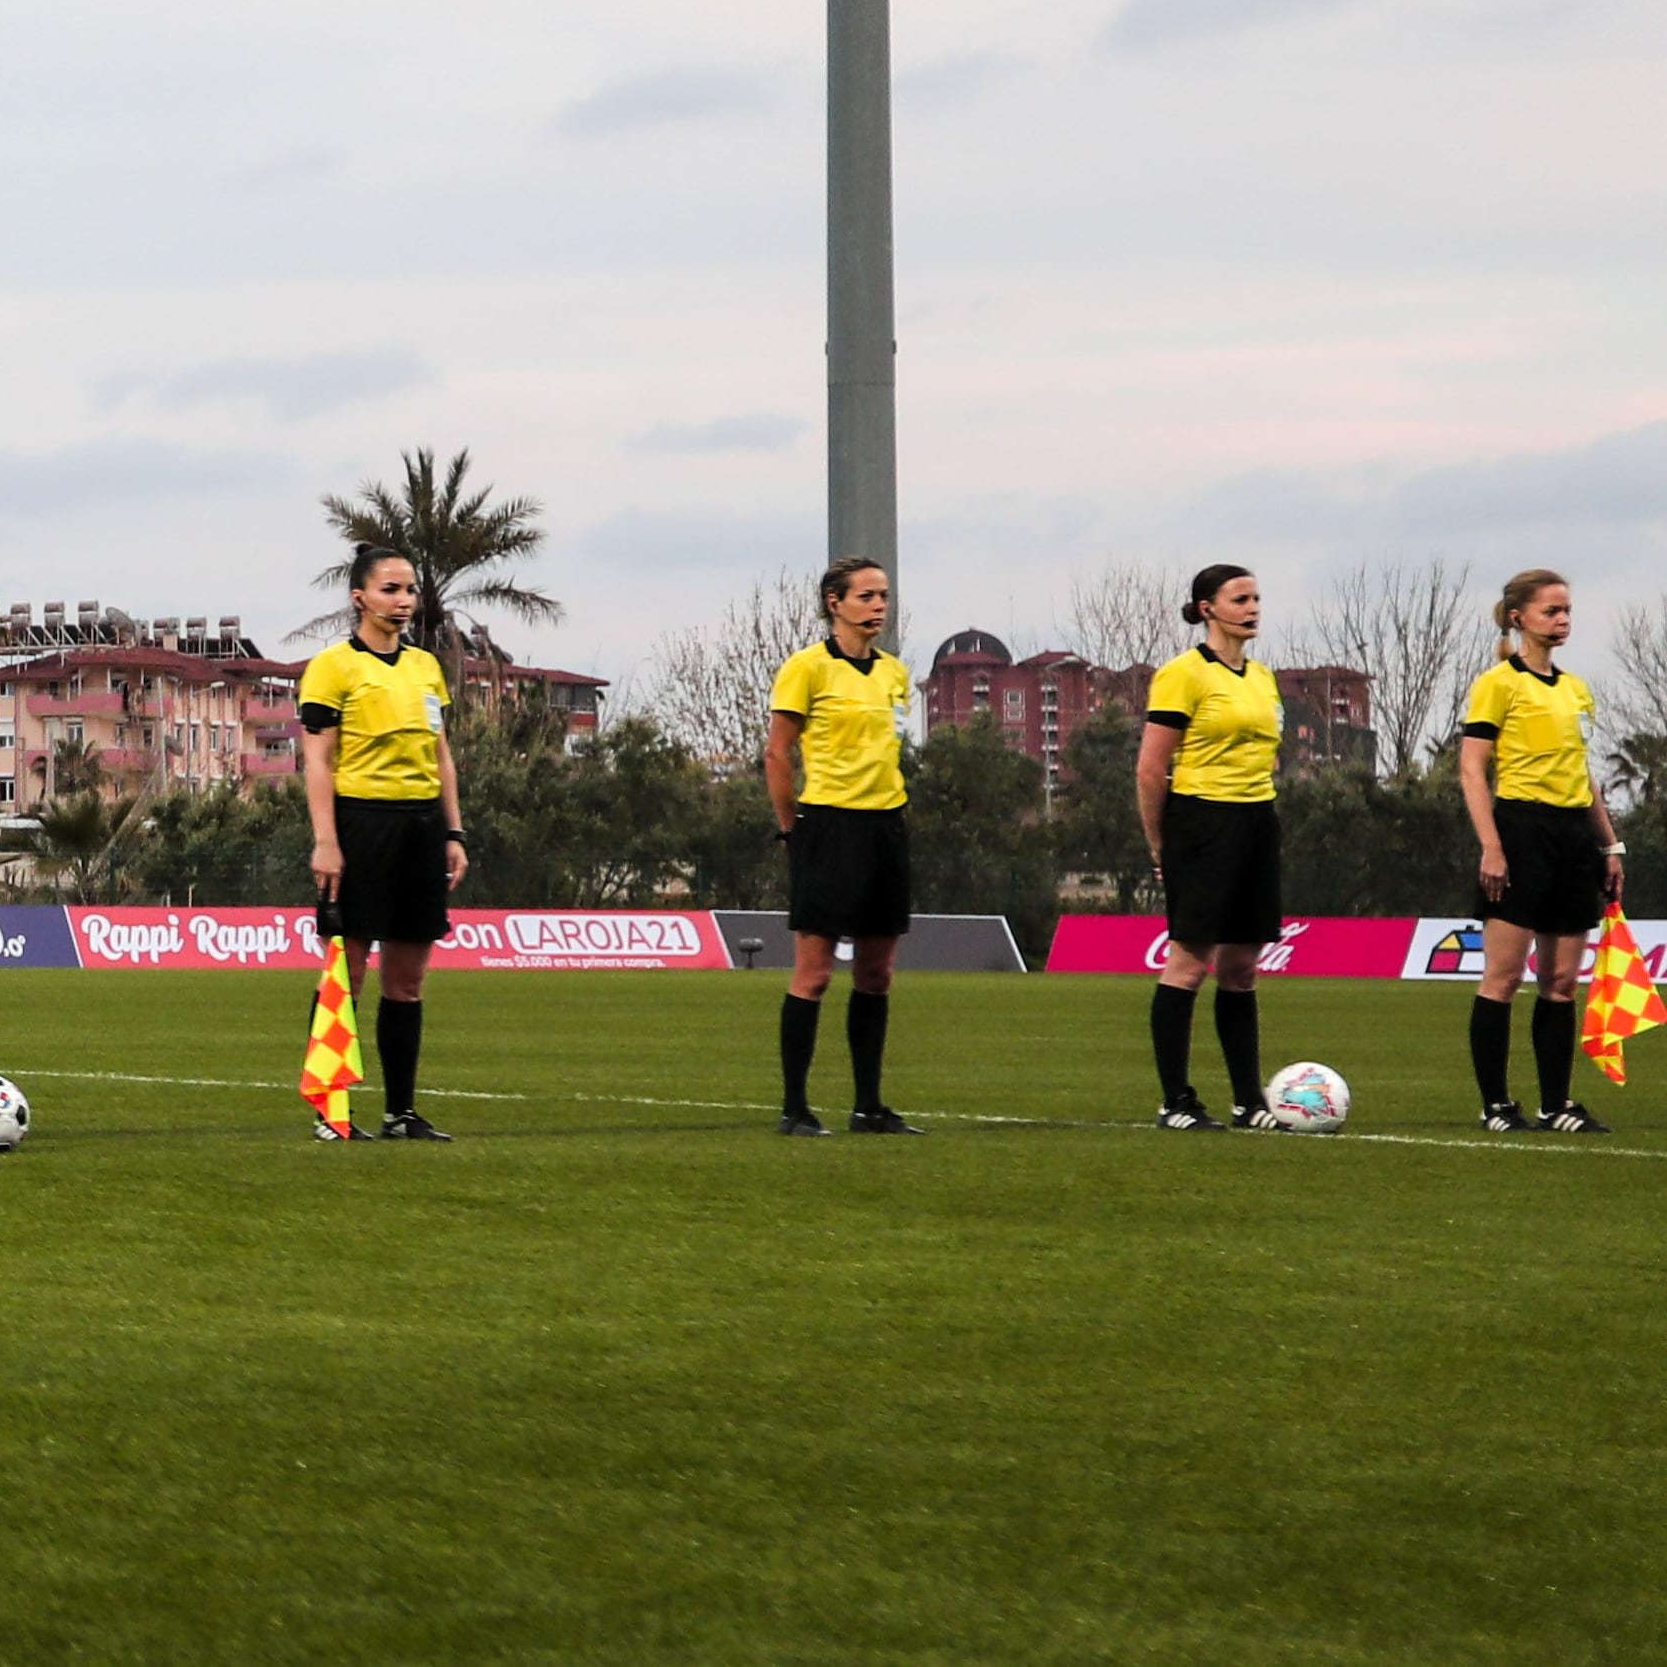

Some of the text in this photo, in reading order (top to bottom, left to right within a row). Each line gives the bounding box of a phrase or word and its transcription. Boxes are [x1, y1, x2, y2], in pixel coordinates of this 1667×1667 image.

[81, 914, 185, 964] Rappi
[189, 914, 291, 964] Rappi
[513, 919, 694, 951] LAROJA21
